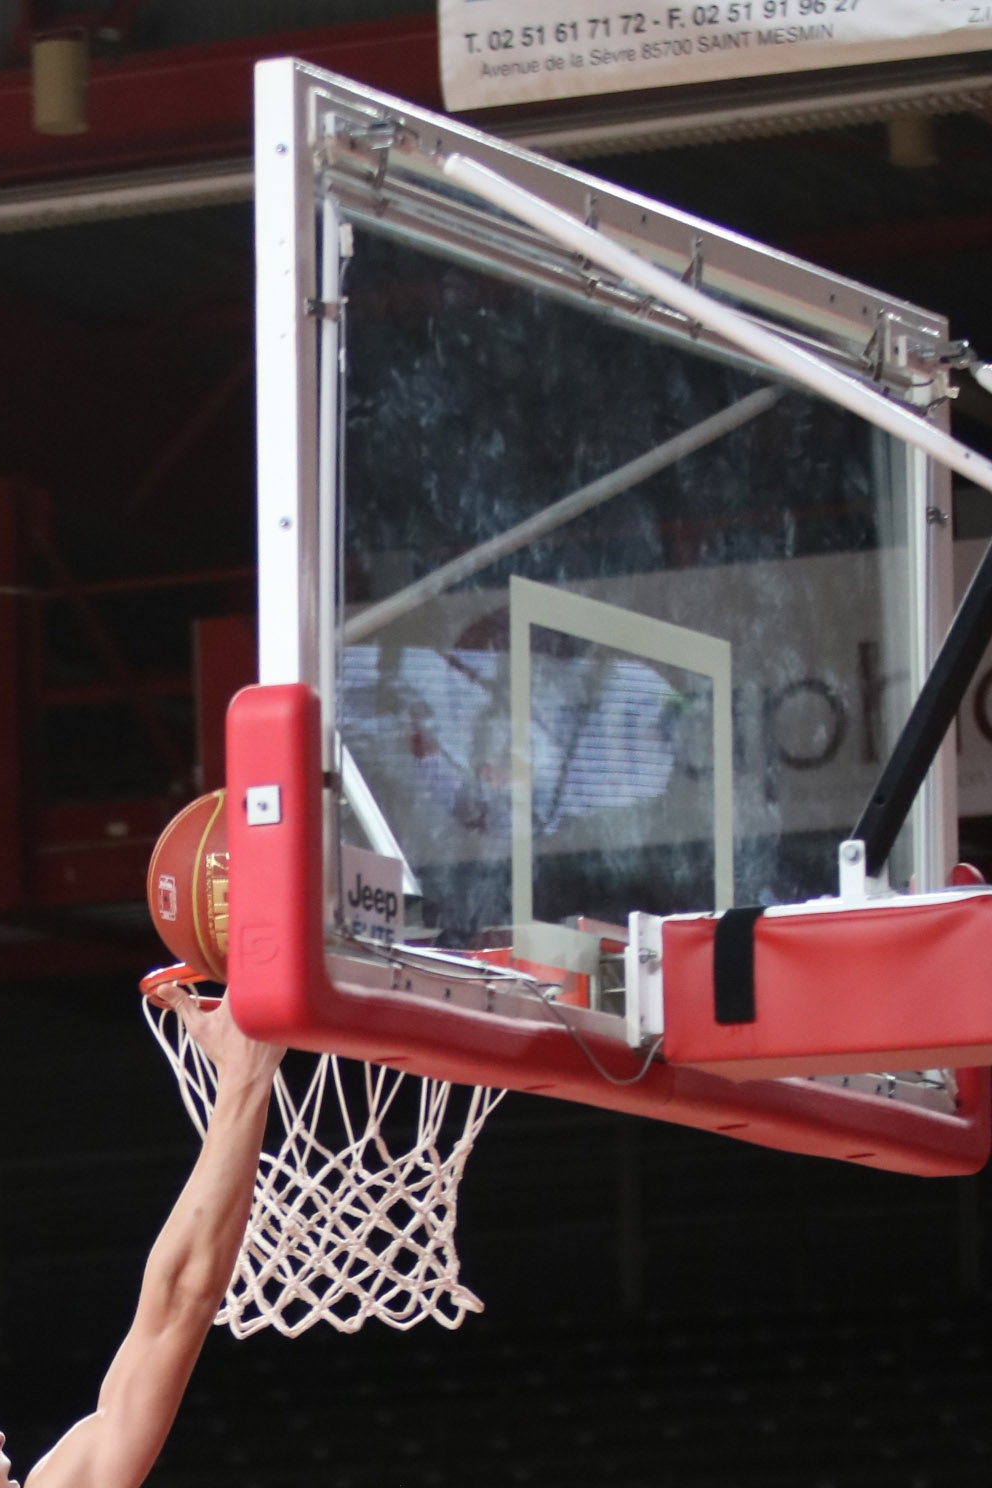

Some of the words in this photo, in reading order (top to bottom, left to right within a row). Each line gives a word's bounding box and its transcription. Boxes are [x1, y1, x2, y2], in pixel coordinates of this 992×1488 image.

[464, 32, 481, 54] T.
[488, 28, 515, 51] 02
[521, 24, 545, 47] 51
[556, 21, 579, 43] 61
[588, 18, 612, 39] 71
[620, 13, 647, 35] 72
[669, 8, 686, 29] F.
[692, 5, 720, 26] 02
[727, 2, 753, 23] 51
[763, 0, 788, 19] 91
[480, 60, 540, 79] Avenue
[544, 53, 565, 71] de
[570, 51, 585, 67] la
[589, 46, 637, 66] Sèvre
[641, 38, 692, 60] 85700
[697, 31, 750, 53] SAINT
[759, 23, 834, 45] MESMIN
[348, 873, 397, 923] Jeep
